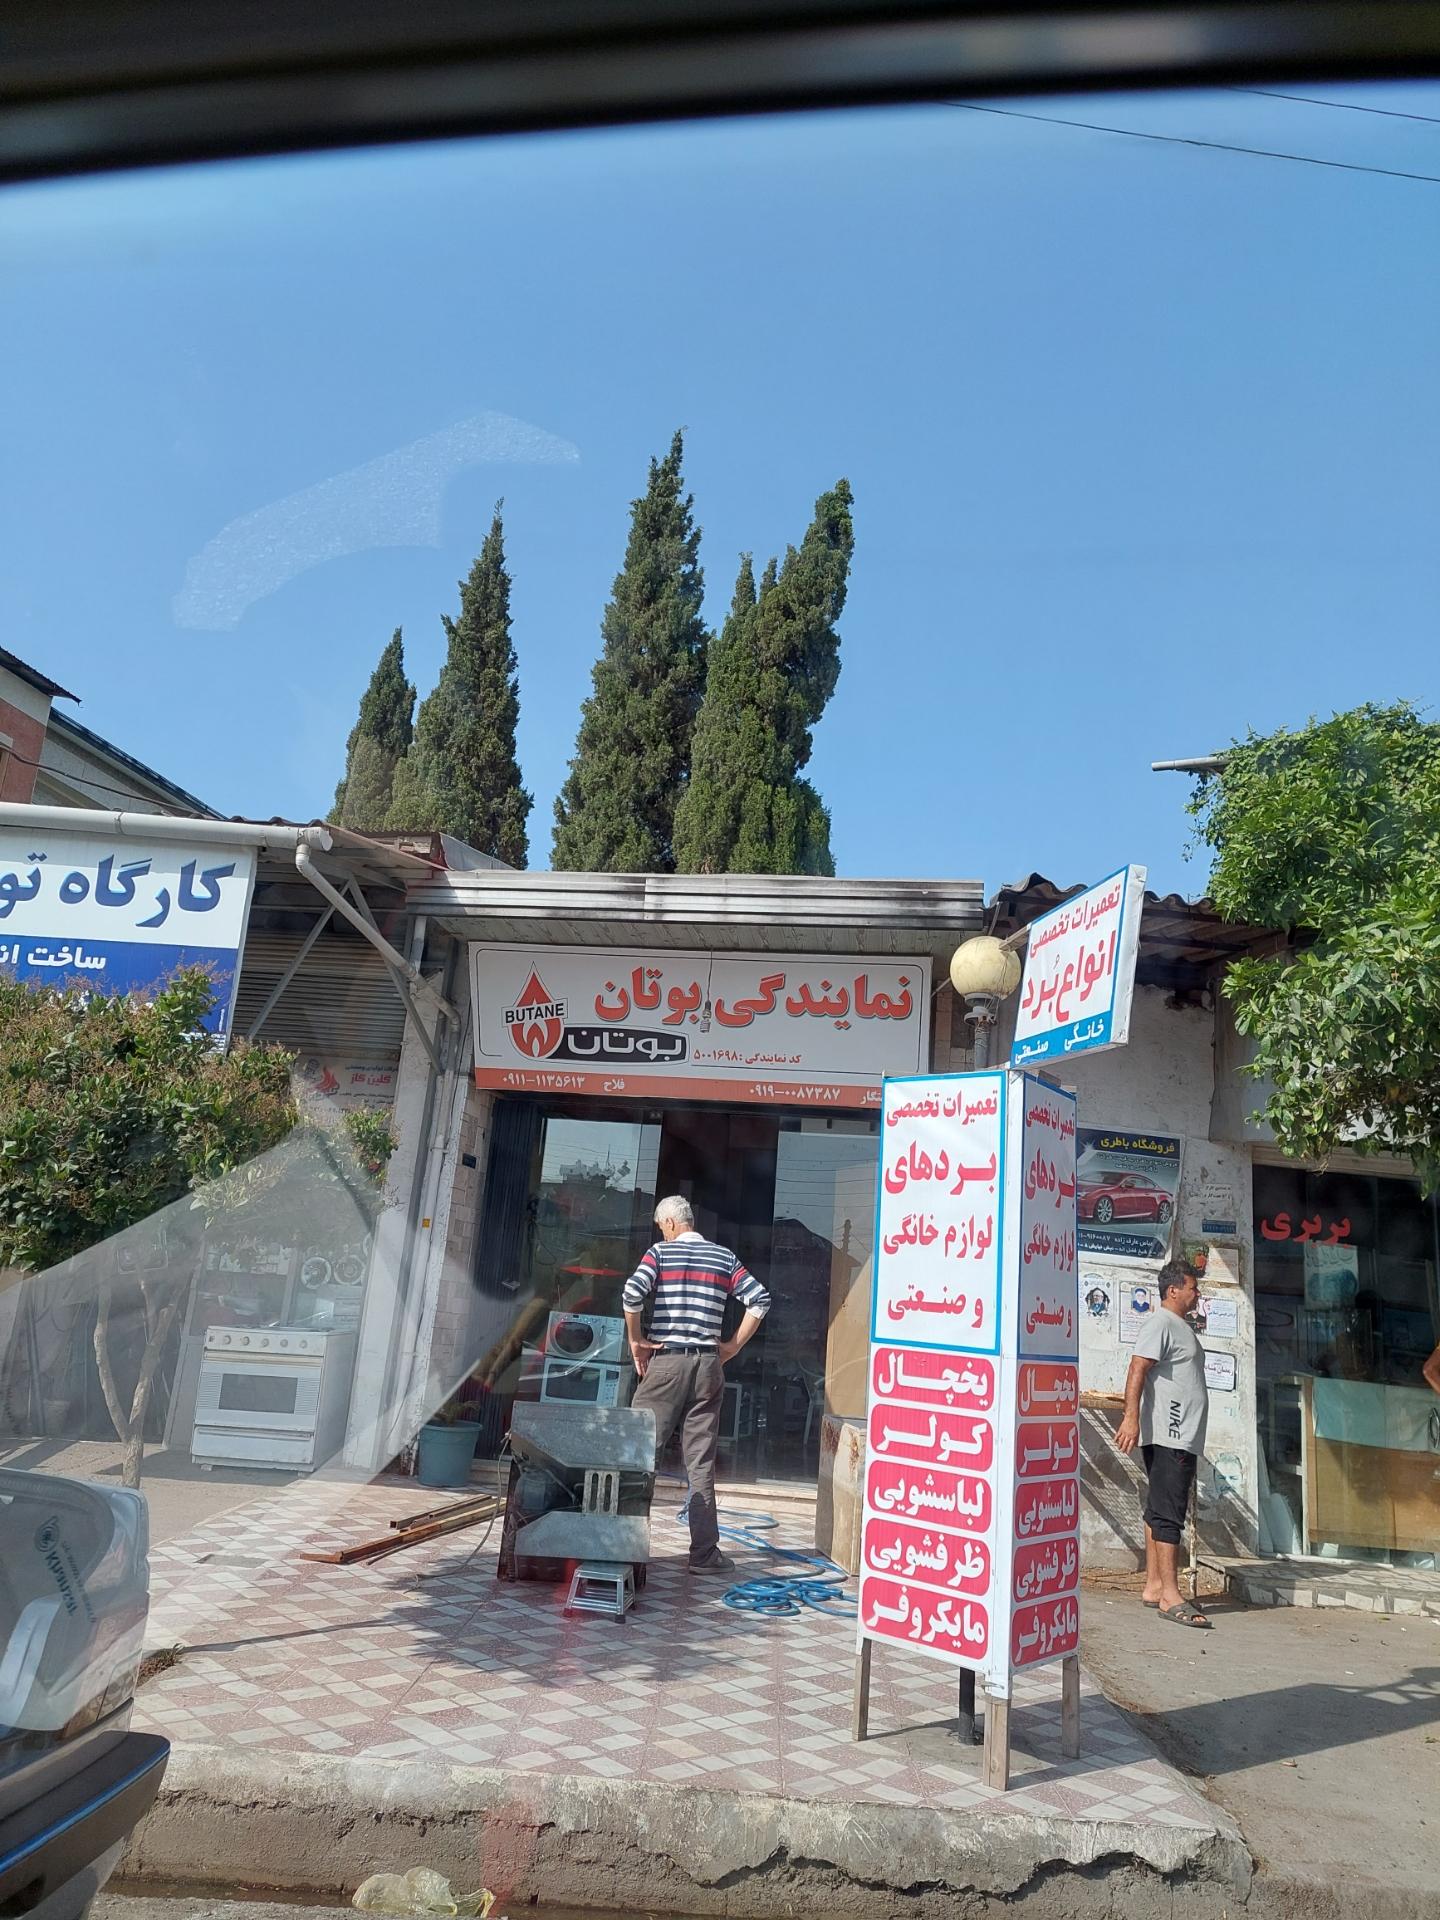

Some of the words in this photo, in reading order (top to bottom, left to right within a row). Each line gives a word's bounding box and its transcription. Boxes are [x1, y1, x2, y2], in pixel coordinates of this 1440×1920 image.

[0, 852, 48, 919] تو
[59, 854, 236, 928] کارگاه
[1071, 884, 1121, 931] تعمیرات
[1030, 912, 1070, 958] تخصصی
[27, 945, 107, 970] ساخت
[1055, 930, 1117, 1022] انواع
[505, 1002, 564, 1024] BUTANE
[594, 966, 703, 1026] بوتان
[715, 972, 913, 1030] نمایندگی
[567, 1030, 682, 1062] بوتان
[1015, 1038, 1049, 1065] صنعتی
[1064, 1018, 1105, 1051] خانگی
[744, 1052, 787, 1066] نمایندگی
[788, 1054, 802, 1064] کد
[603, 1078, 625, 1092] فلاح
[886, 1093, 940, 1127] تخصصی
[943, 1089, 998, 1126] تعمیرات
[1026, 1102, 1051, 1128] تخصصی
[1051, 1106, 1075, 1141] تعمیرات
[1100, 1137, 1129, 1150] باطری
[1132, 1138, 1175, 1154] فروشگاه
[884, 1140, 997, 1195] بردهای
[1025, 1146, 1075, 1210] بردهای
[883, 1213, 939, 1255] خانگی
[944, 1214, 993, 1260] لوازم
[1024, 1221, 1051, 1265] خانگی
[1053, 1228, 1075, 1272] لوازم
[1260, 1211, 1352, 1249] بربری
[887, 1284, 967, 1321] صنعتی
[971, 1298, 984, 1328] و
[1026, 1295, 1065, 1335] صنعتی
[1066, 1308, 1072, 1338] و
[878, 1352, 988, 1406] یخچال
[1021, 1368, 1076, 1415] یخچال
[877, 1413, 988, 1462] کولر
[1169, 1400, 1181, 1440] NIKE
[1019, 1424, 1076, 1474] کولر
[874, 1473, 984, 1527] لباسشویی
[1018, 1481, 1075, 1535] لباسشویی
[870, 1533, 985, 1587] ظرفشویی
